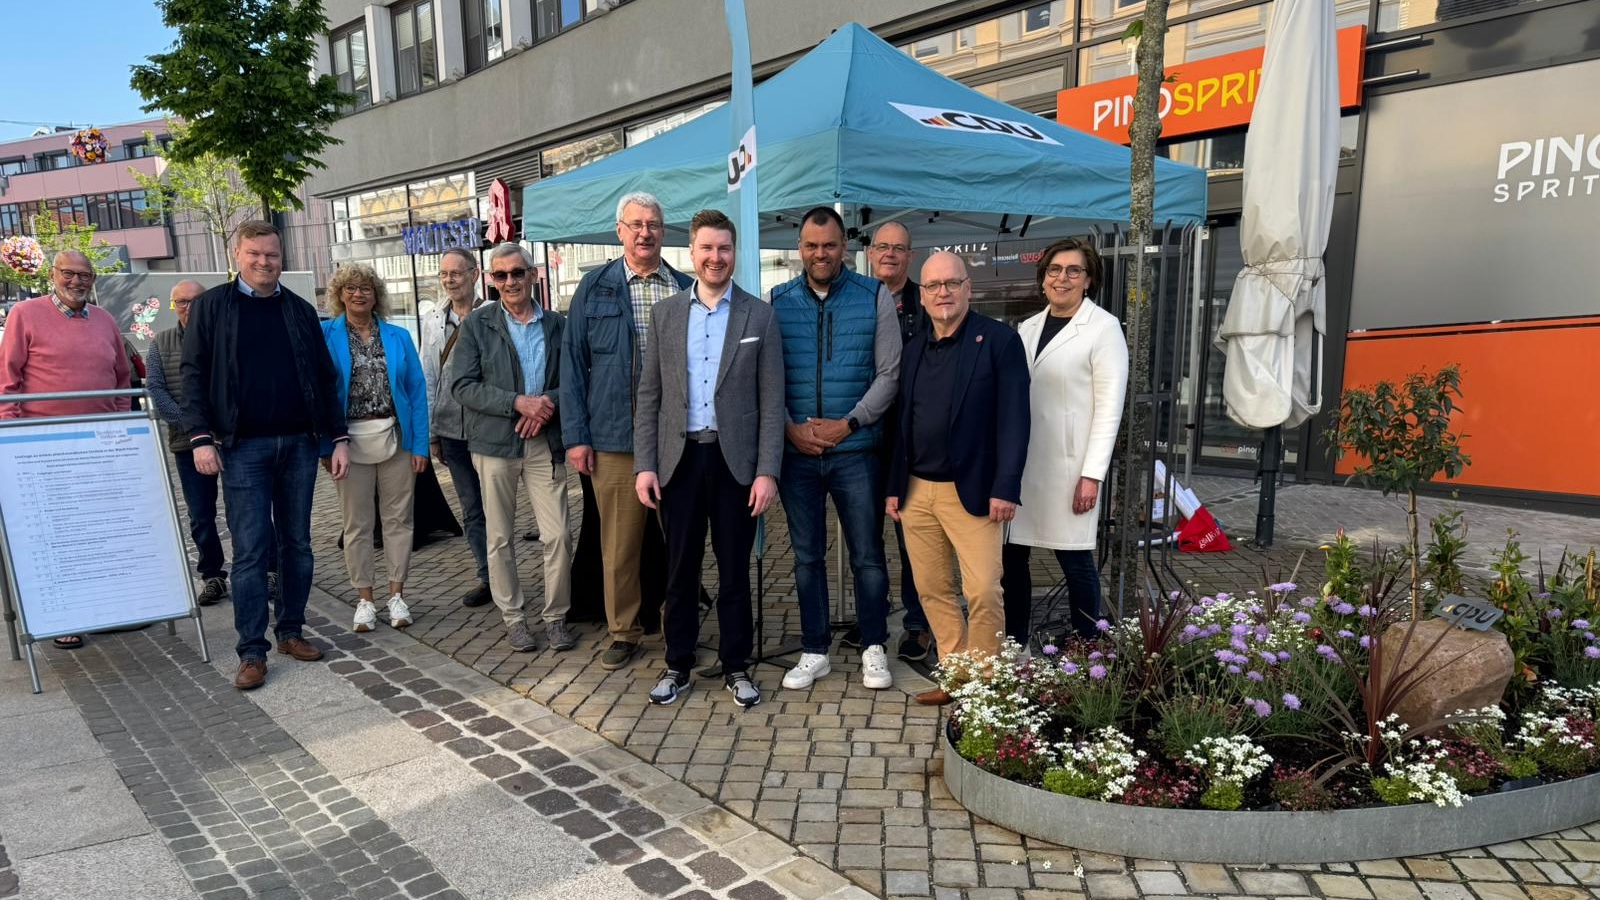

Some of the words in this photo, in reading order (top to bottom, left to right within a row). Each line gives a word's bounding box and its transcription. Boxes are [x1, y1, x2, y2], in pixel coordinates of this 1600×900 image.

[942, 112, 1044, 140] CDU
[402, 217, 480, 255] MALTESER
[1452, 603, 1497, 624] CDU
